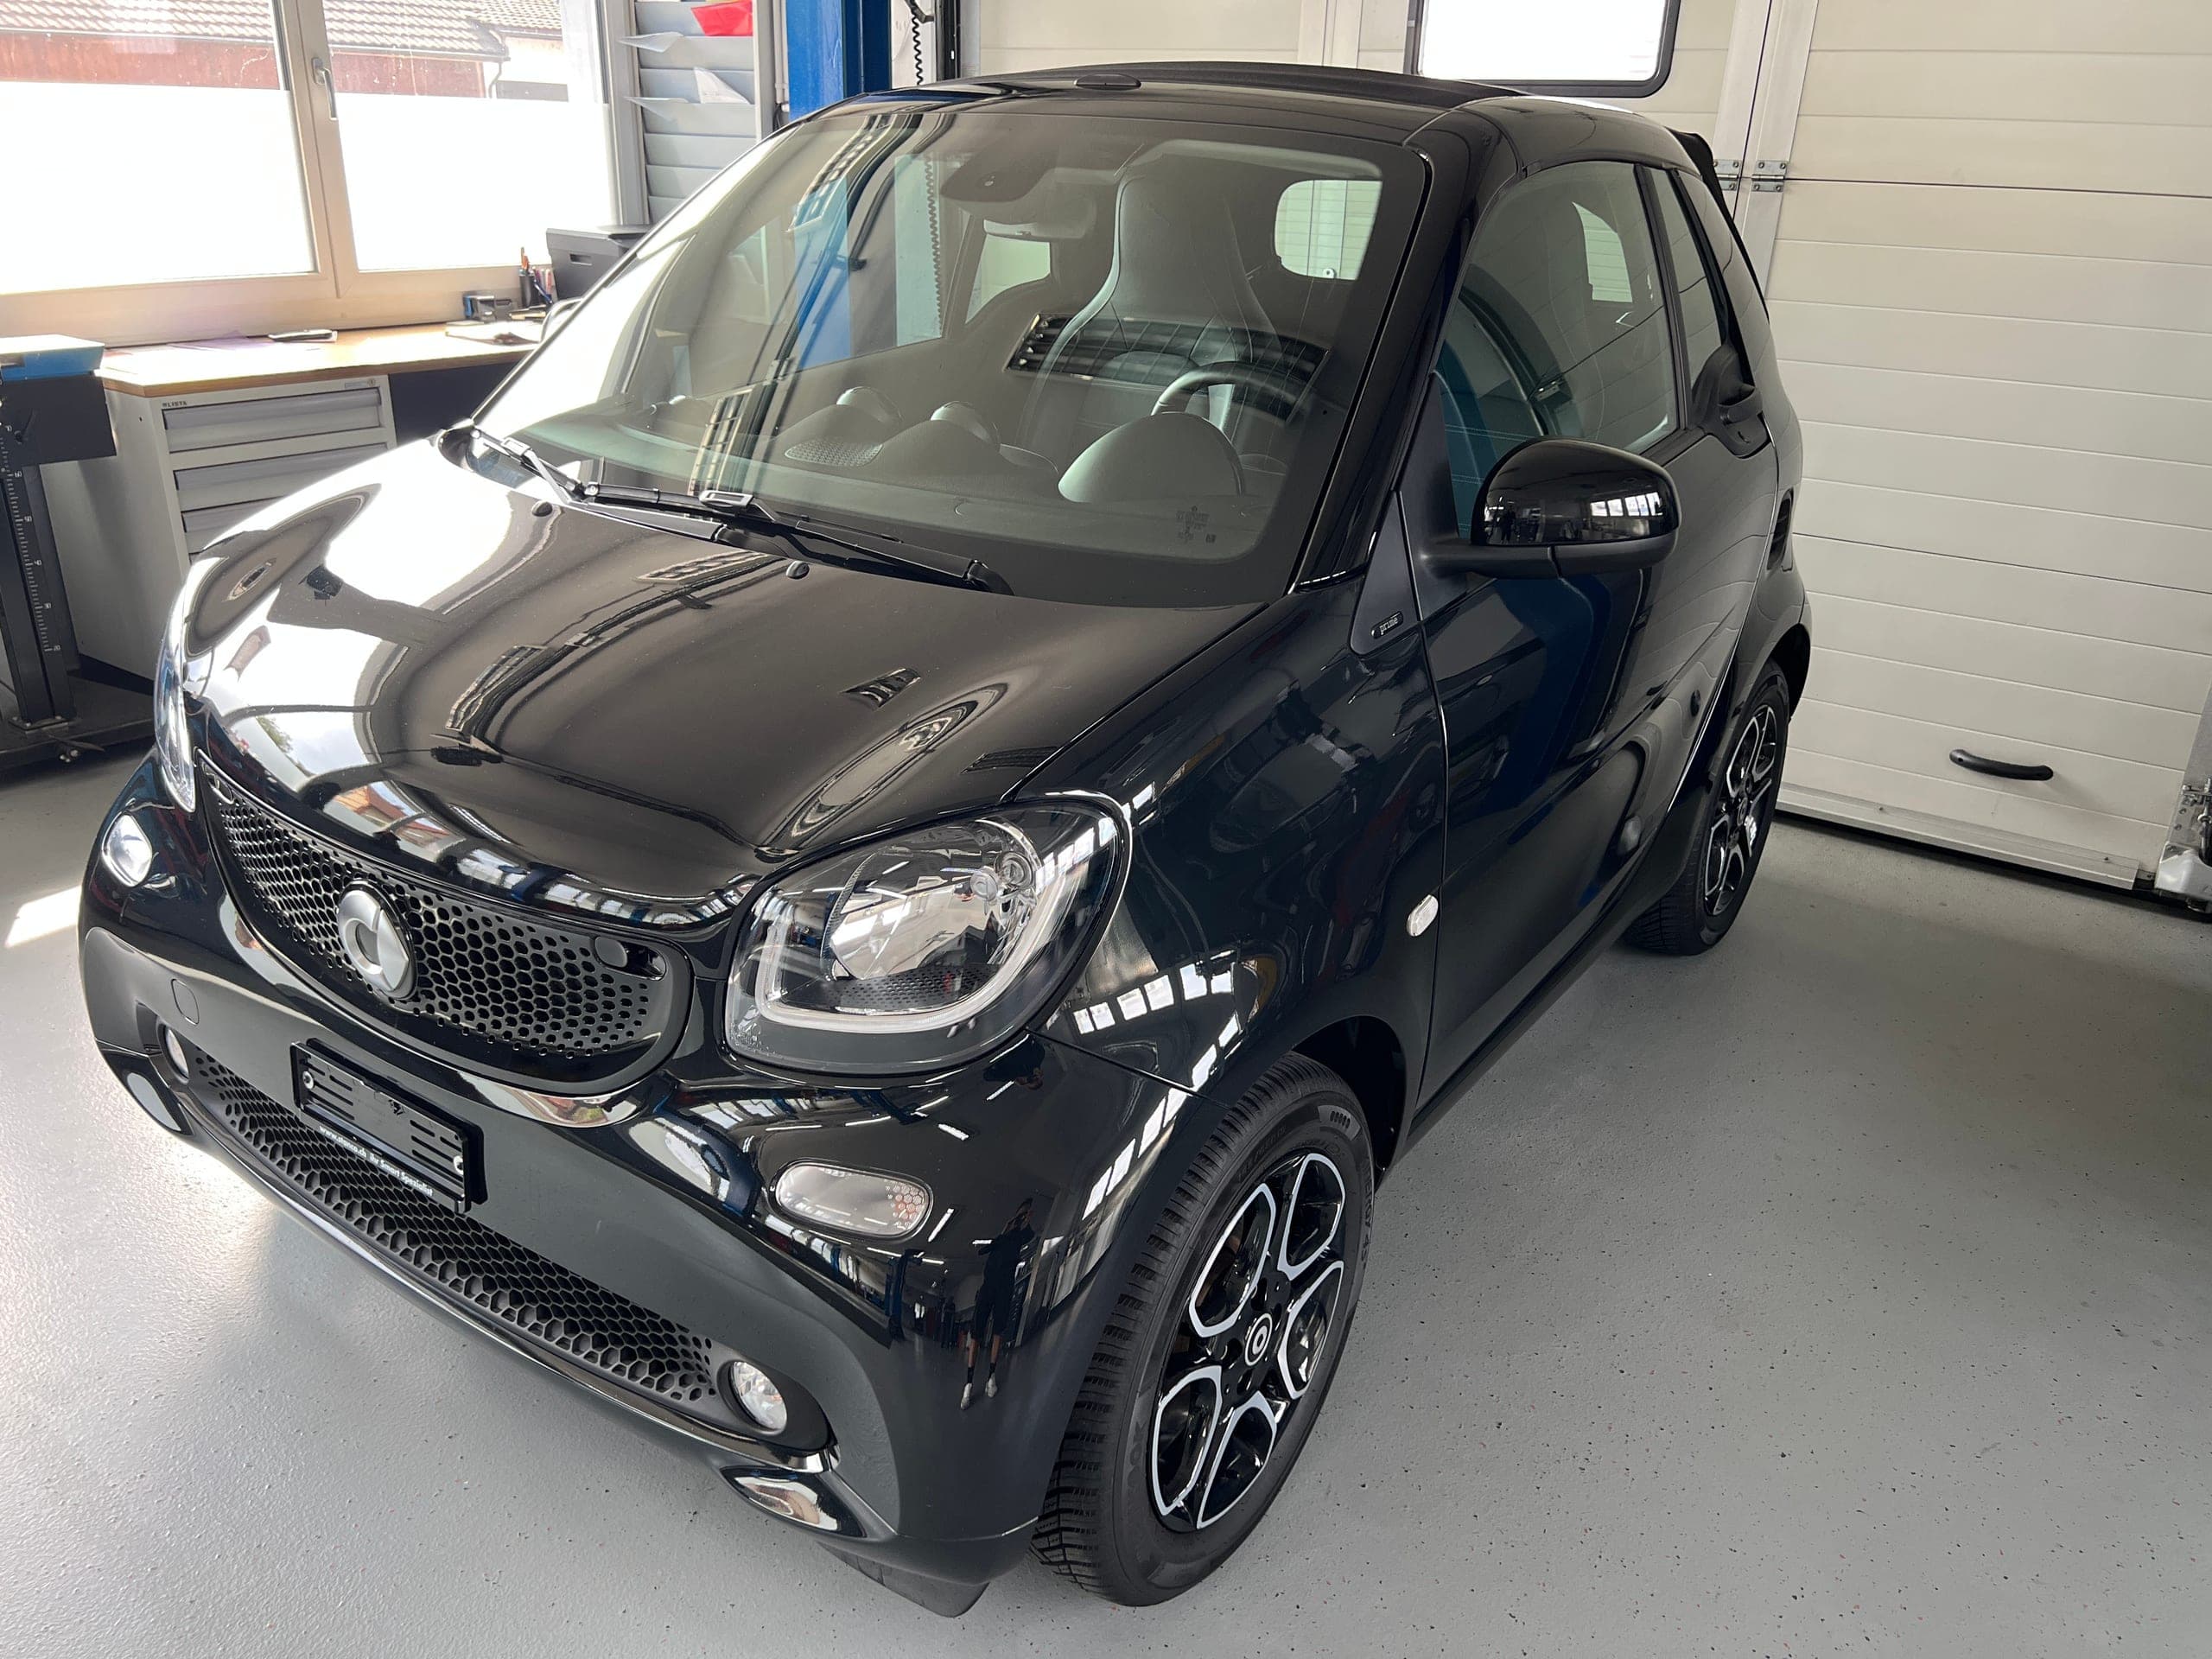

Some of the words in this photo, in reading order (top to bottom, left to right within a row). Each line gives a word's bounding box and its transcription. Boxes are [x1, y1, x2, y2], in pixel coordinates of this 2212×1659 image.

[1380, 617, 1399, 636] prime
[380, 1160, 400, 1178] Smart
[401, 1172, 433, 1197] Spezialist
